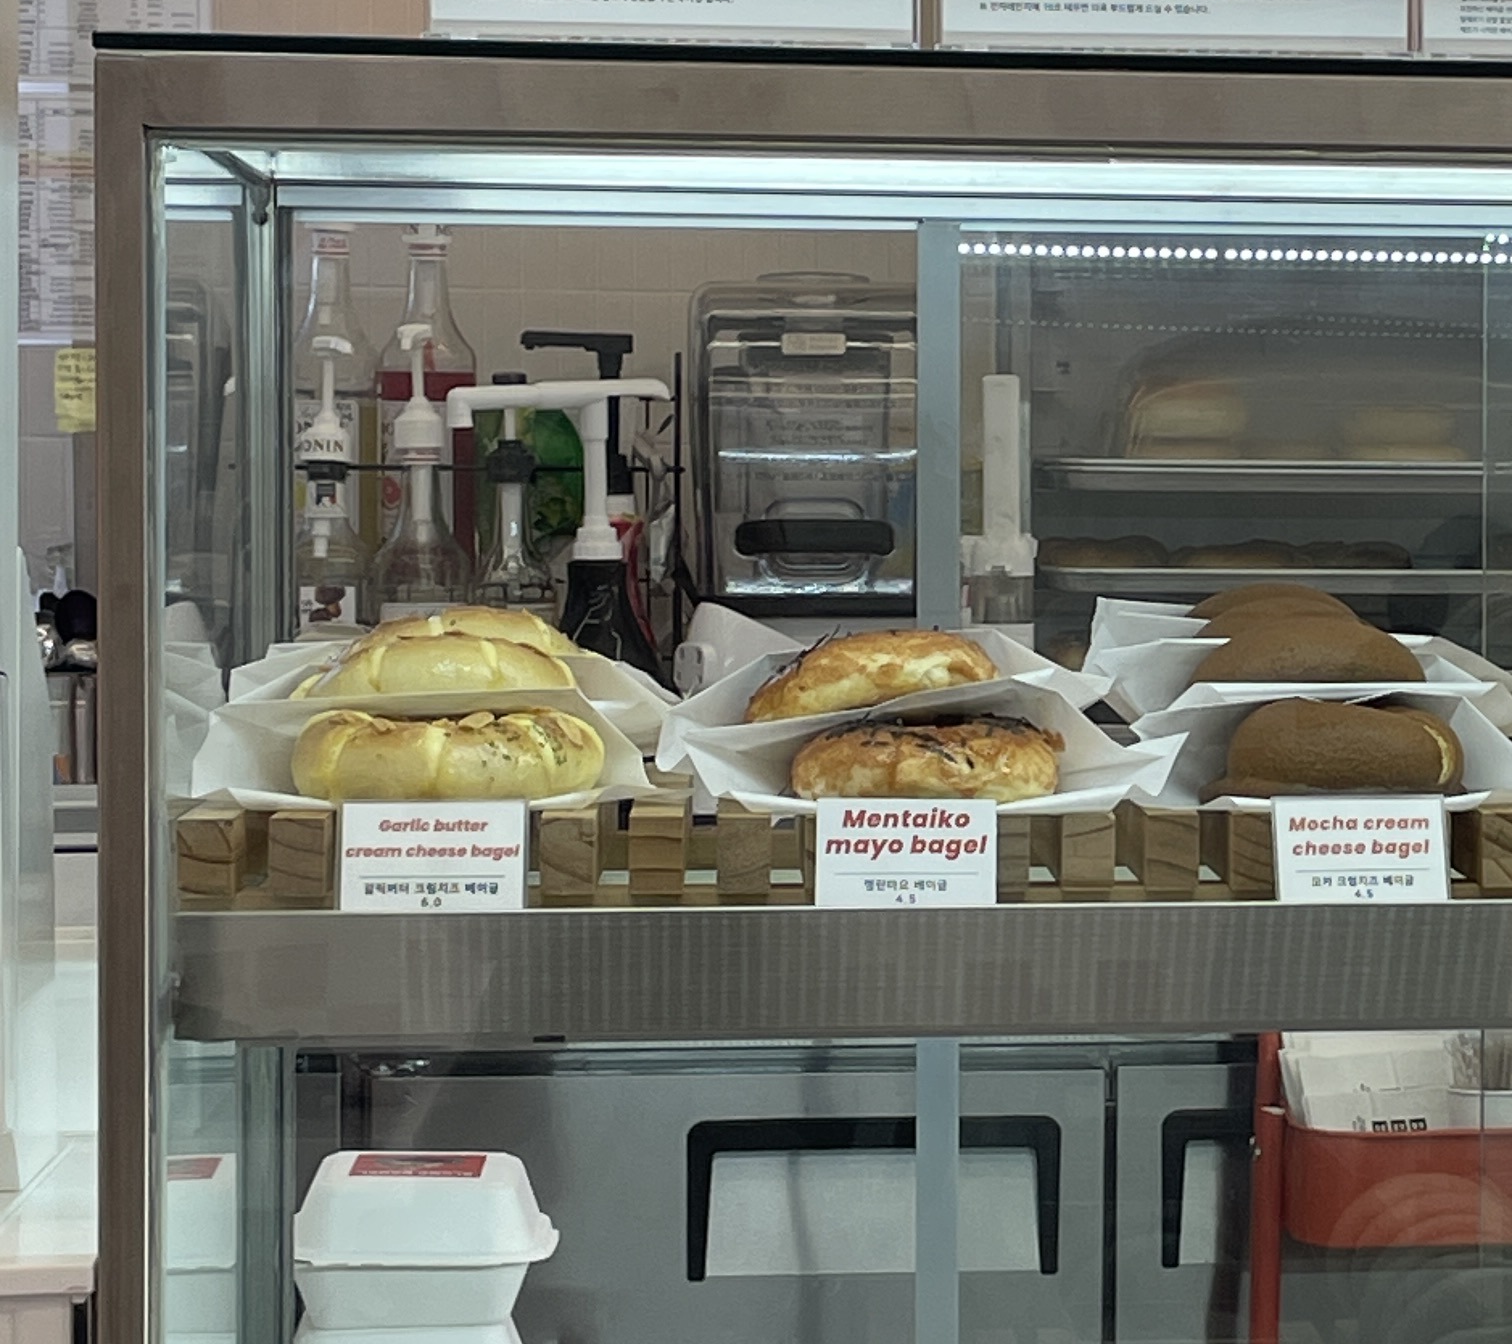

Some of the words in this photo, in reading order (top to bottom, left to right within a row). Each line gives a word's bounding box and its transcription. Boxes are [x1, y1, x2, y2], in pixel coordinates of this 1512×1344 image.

[379, 819, 430, 832] Garlic
[434, 819, 488, 832] butter
[842, 807, 970, 828] Mentaiko
[1288, 816, 1358, 831] Mocha
[1364, 818, 1429, 830] cream
[346, 847, 402, 857] cream
[406, 845, 467, 857] cheese
[471, 844, 520, 860] bagel
[825, 838, 903, 860] mayo
[910, 835, 987, 860] bagel
[1293, 841, 1365, 856] cheese
[1372, 839, 1430, 859] bagel
